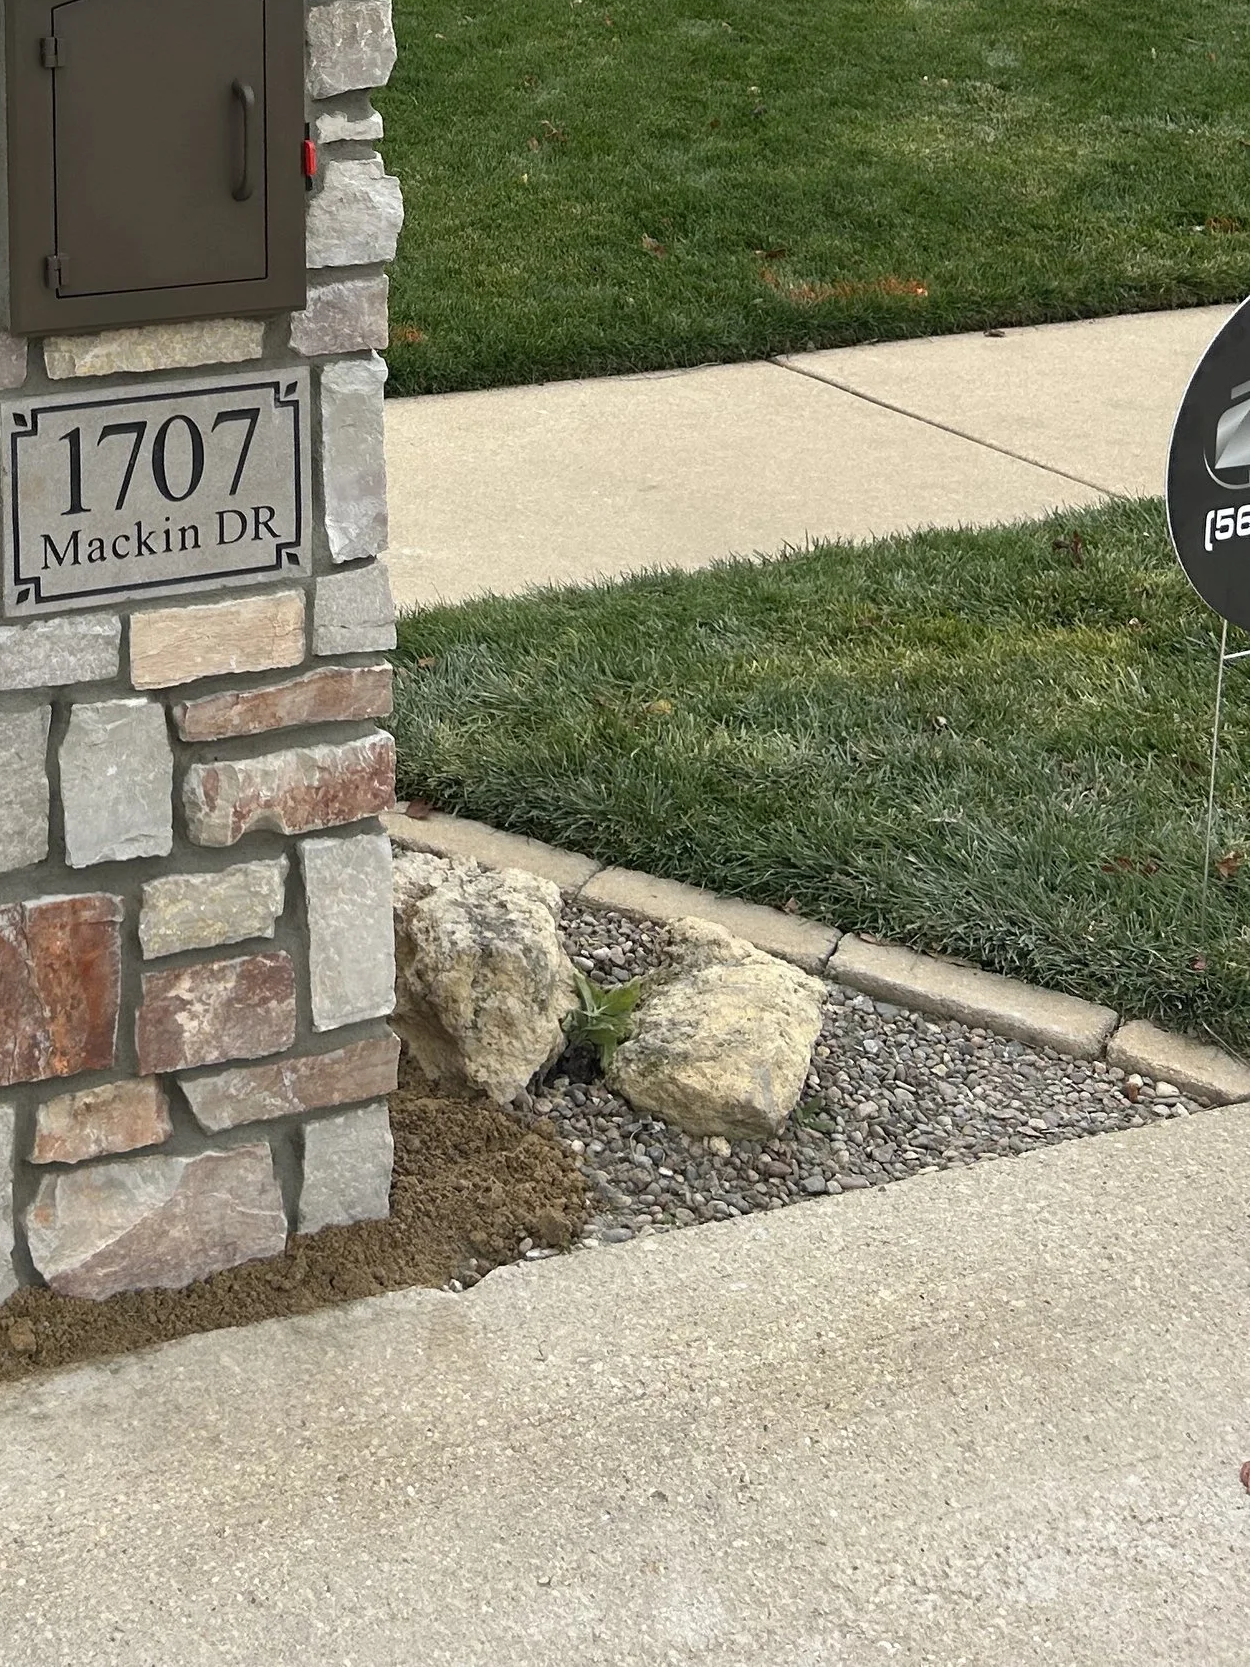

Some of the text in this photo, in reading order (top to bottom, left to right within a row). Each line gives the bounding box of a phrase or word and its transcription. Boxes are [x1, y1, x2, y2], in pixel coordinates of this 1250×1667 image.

[58, 407, 261, 516] 1707
[40, 505, 282, 570] Mackin DR
